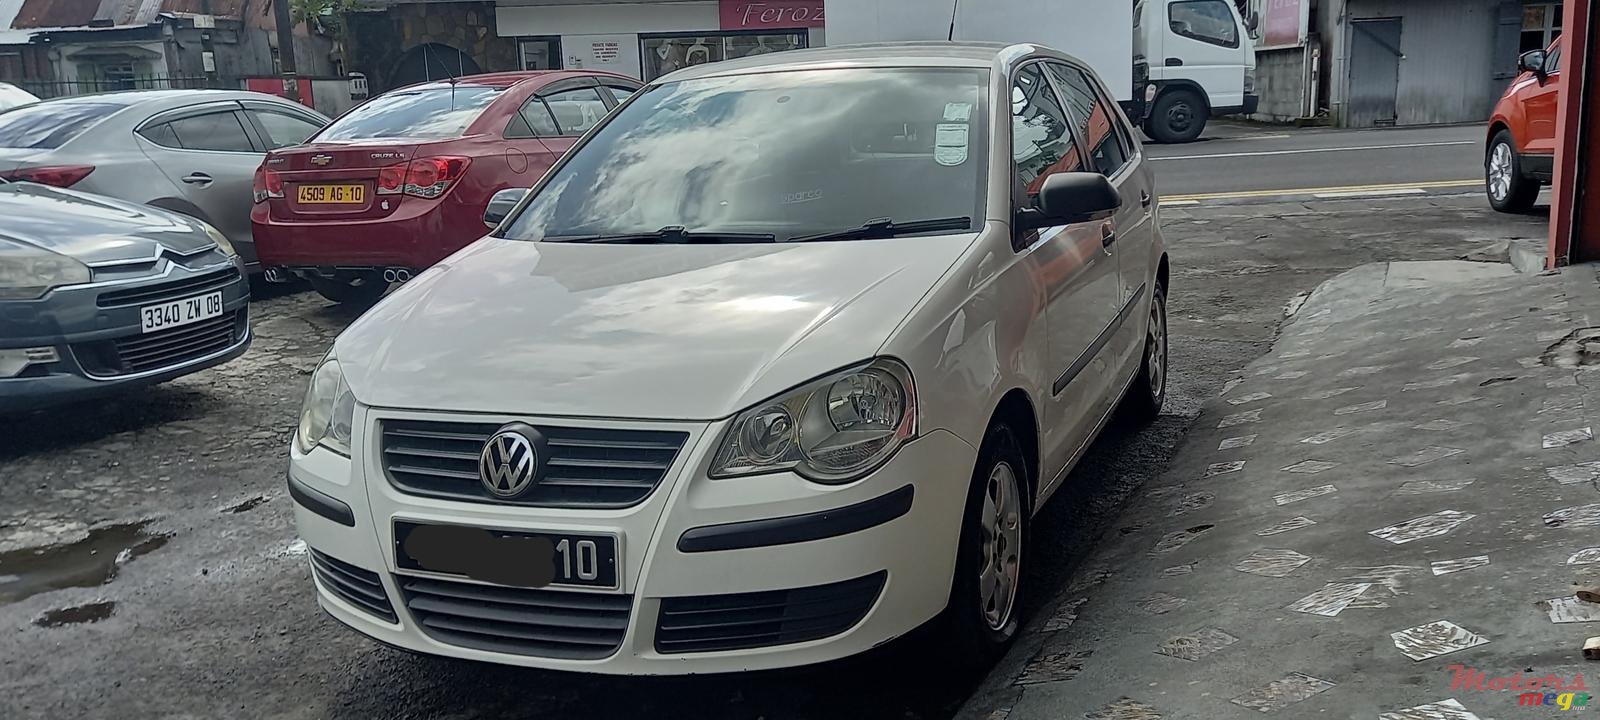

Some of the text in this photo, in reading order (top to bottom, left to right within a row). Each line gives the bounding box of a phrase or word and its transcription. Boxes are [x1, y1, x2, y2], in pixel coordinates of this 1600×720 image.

[300, 187, 325, 201] 4509
[145, 295, 220, 328] 3340 ZW 08
[555, 538, 598, 580] 10
